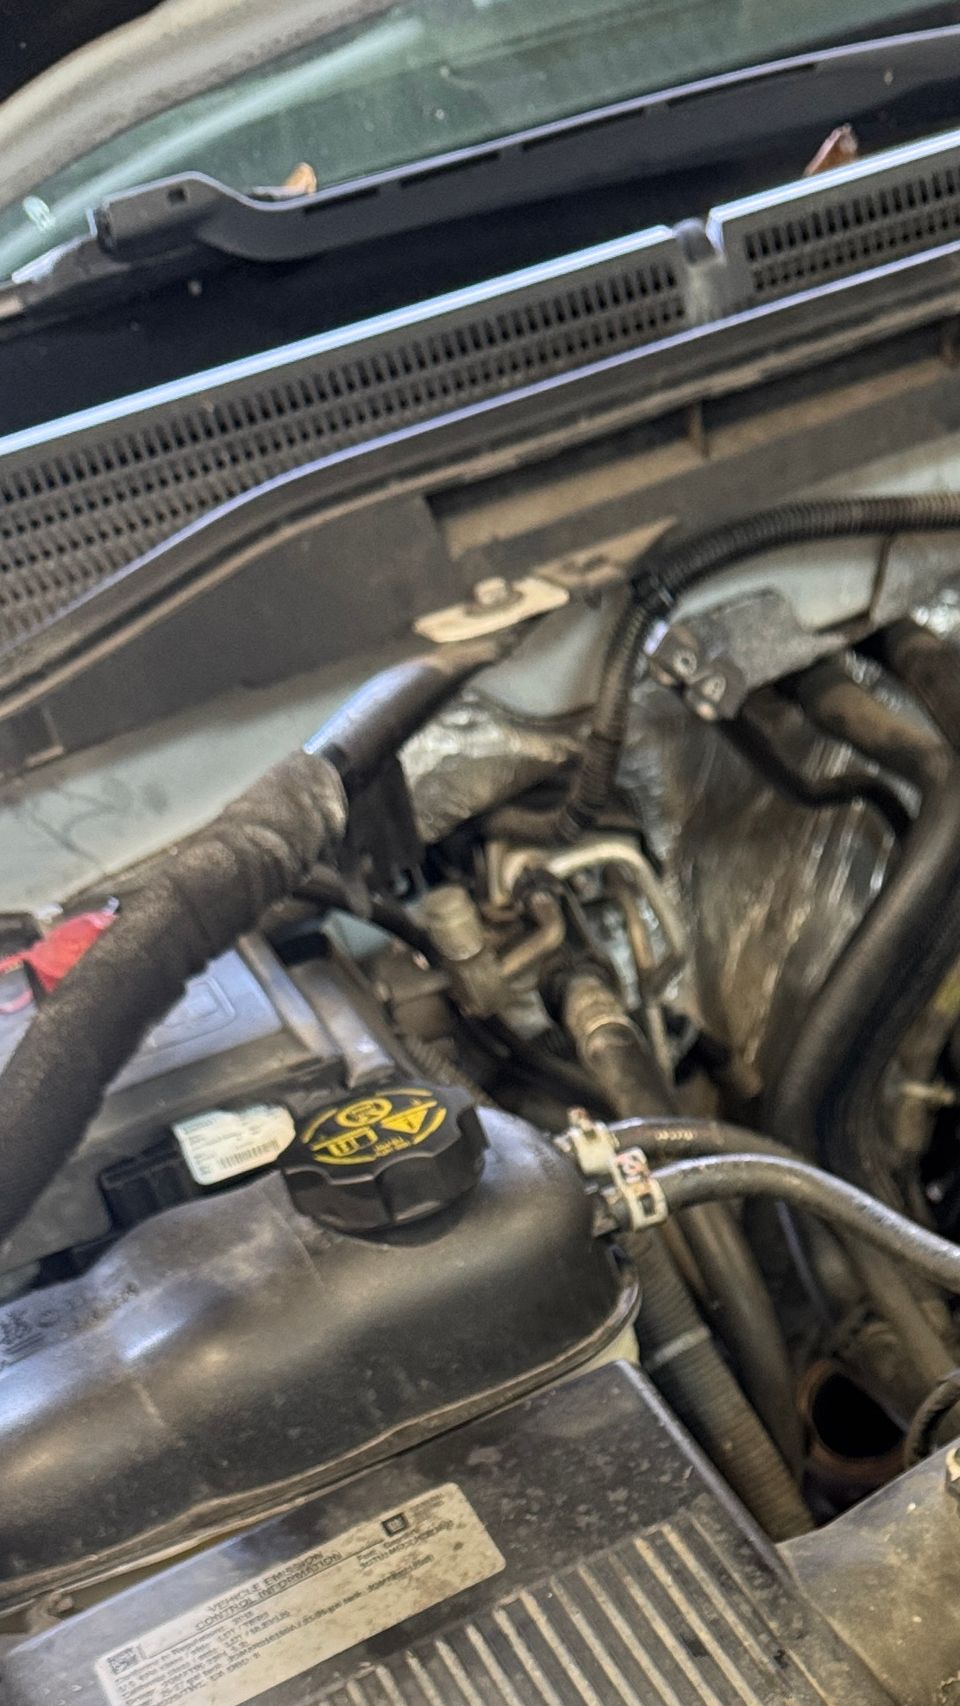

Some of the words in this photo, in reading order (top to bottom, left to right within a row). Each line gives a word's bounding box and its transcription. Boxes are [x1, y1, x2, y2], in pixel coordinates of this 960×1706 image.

[195, 1596, 258, 1631] CONTROL
[258, 1551, 343, 1600] INFORMATION
[208, 1580, 262, 1613] VEHICLE
[264, 1551, 324, 1587] EMISSION
